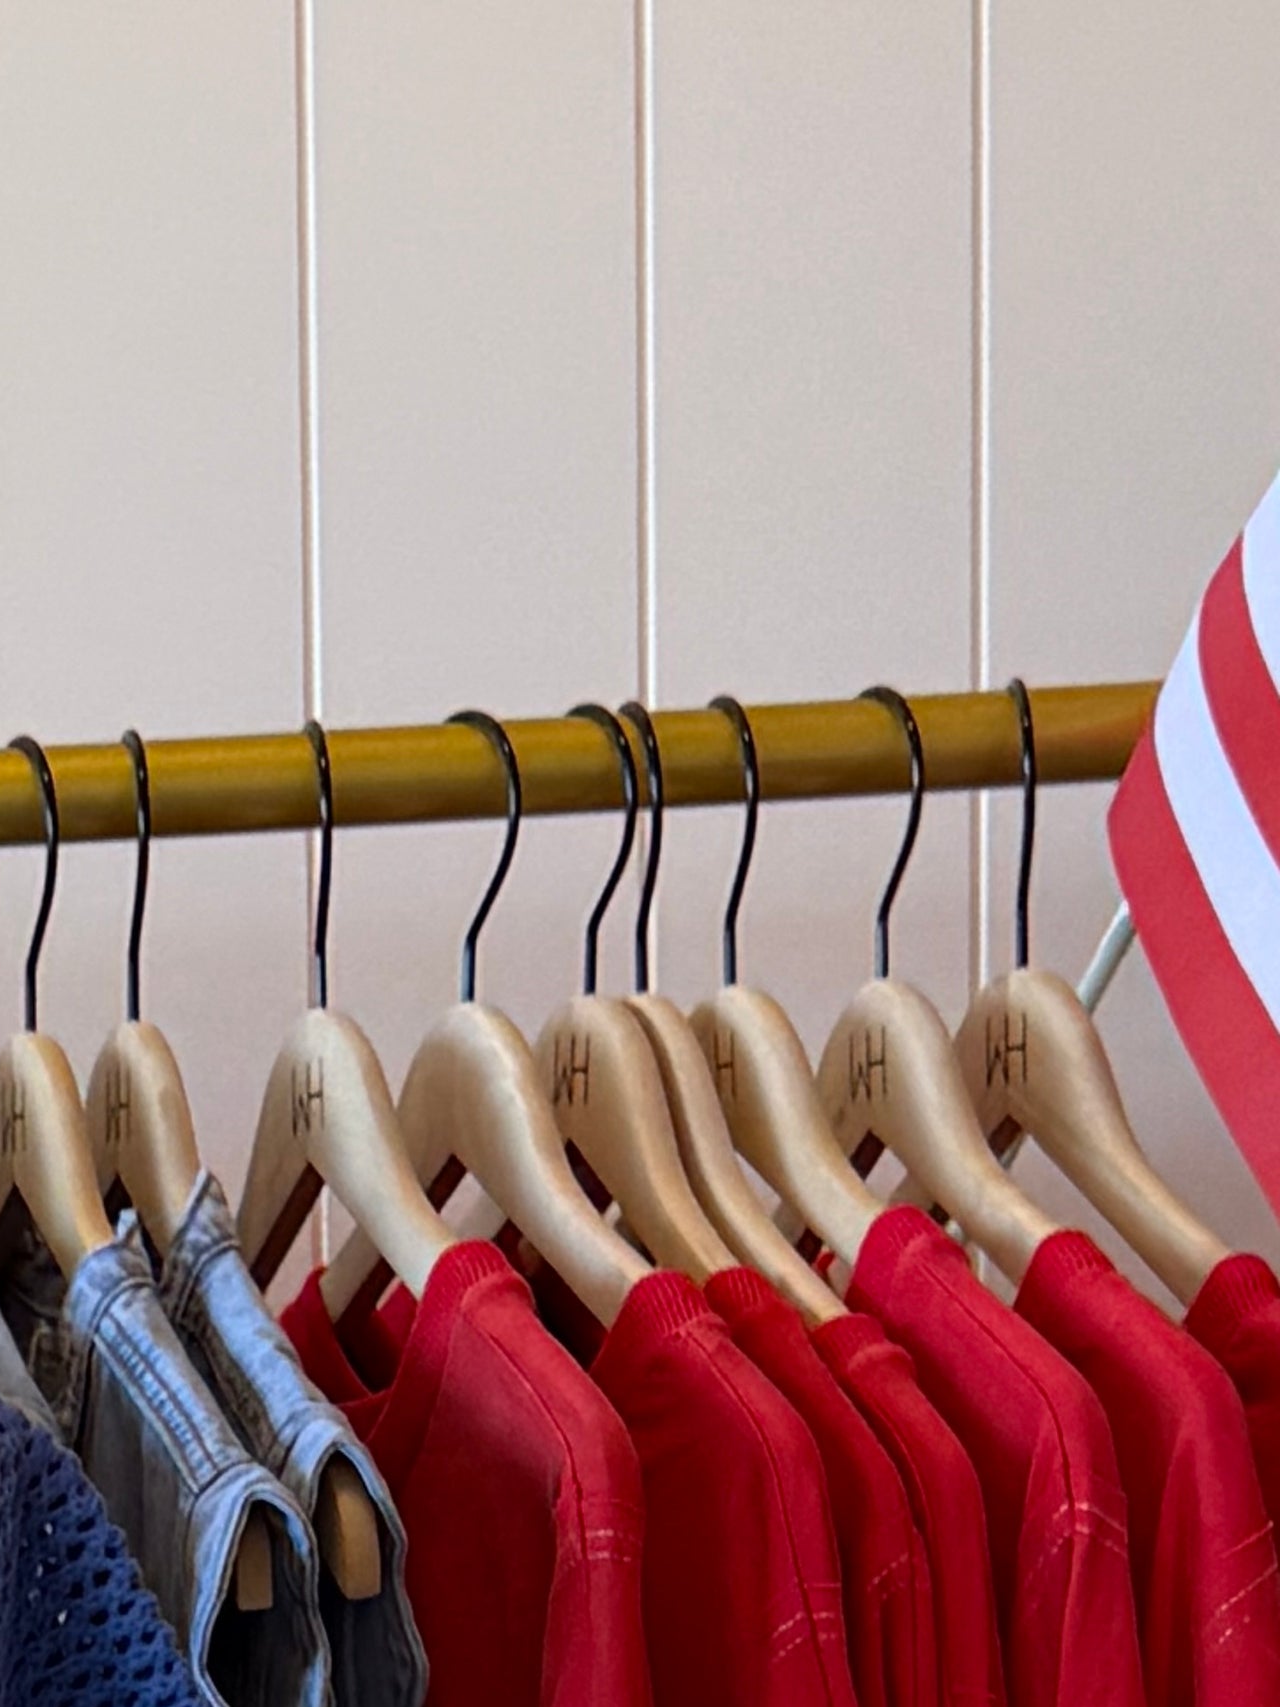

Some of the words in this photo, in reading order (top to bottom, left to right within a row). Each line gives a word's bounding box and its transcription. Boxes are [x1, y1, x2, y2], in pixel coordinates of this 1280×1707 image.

[552, 1031, 590, 1107] WH
[849, 1025, 888, 1102] WH
[985, 1011, 1029, 1089] WH
[291, 1055, 326, 1138] WH
